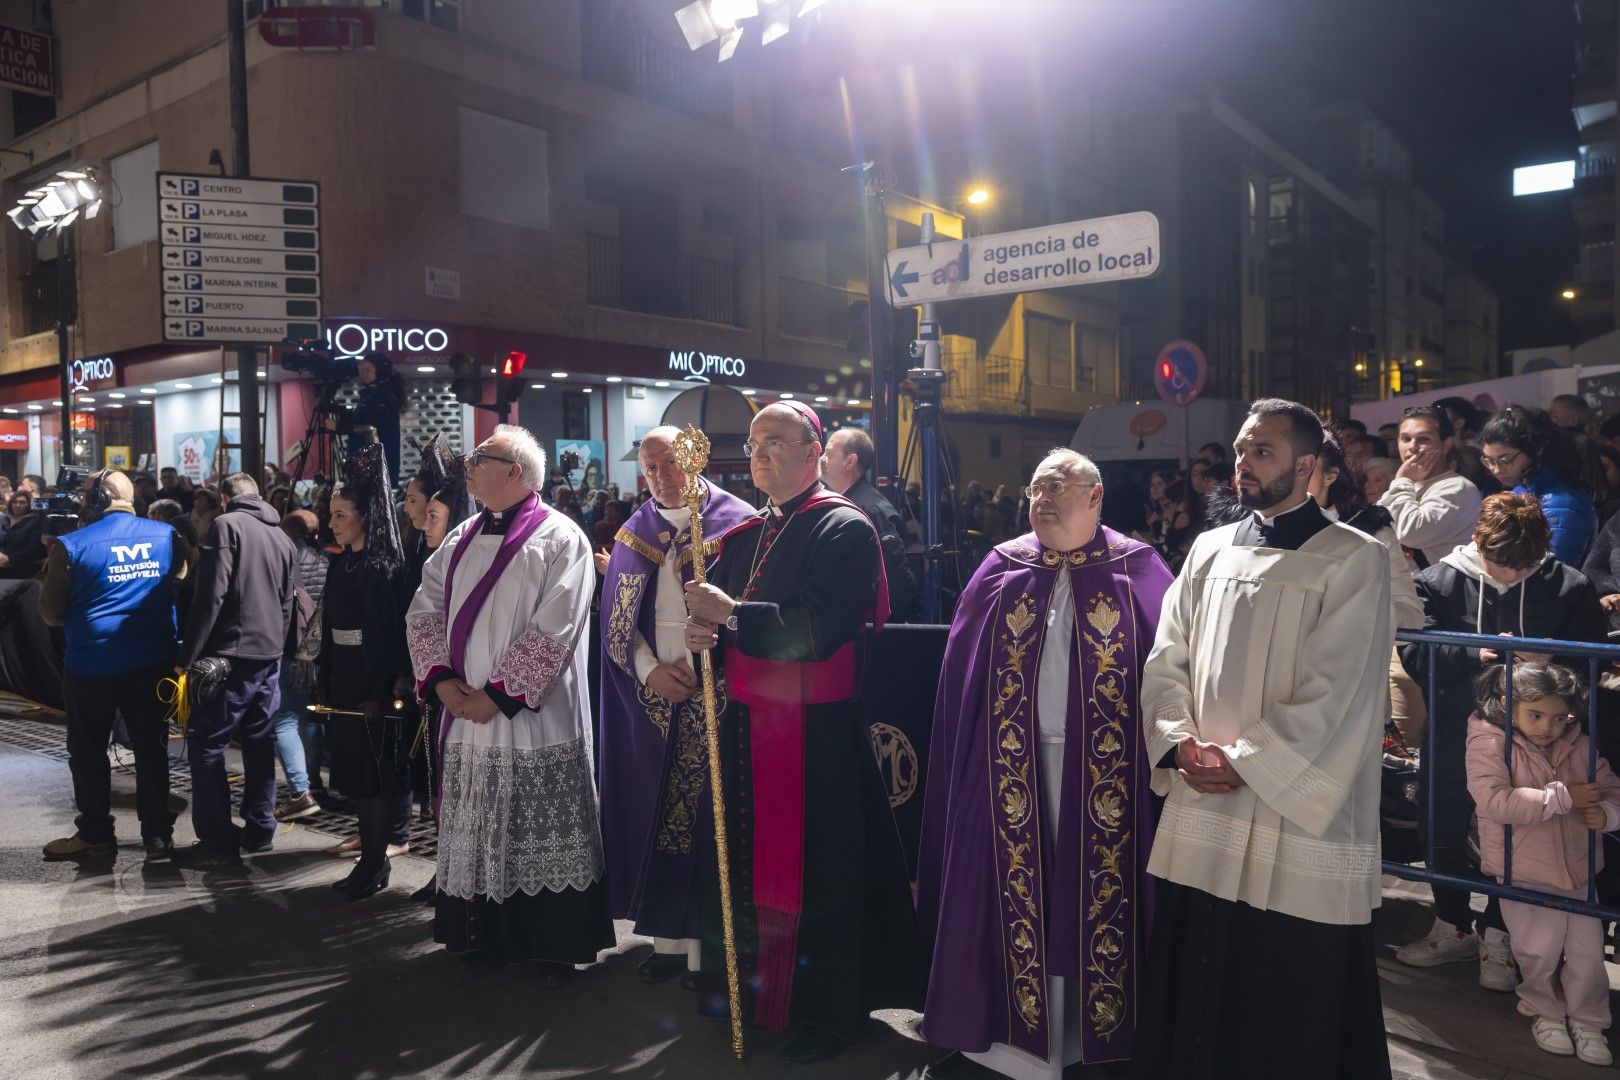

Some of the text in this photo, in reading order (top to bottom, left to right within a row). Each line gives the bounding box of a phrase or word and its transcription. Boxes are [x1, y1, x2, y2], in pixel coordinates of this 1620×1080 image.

[20, 34, 41, 52] DE
[183, 180, 243, 196] P CENTRO
[184, 204, 198, 219] P
[202, 207, 217, 217] LA
[217, 208, 249, 219] PLASA
[184, 227, 198, 243] P
[203, 231, 239, 242] MIGUEL
[983, 230, 1100, 264] agencia de
[185, 251, 199, 266] P
[204, 256, 263, 266] VISTALEGRE
[983, 246, 1153, 286] desarrollo local
[186, 274, 200, 290] P
[204, 279, 242, 288] MARINA
[187, 298, 201, 313] P
[205, 302, 244, 311] PUERTO
[188, 321, 201, 336] P
[206, 325, 243, 335] MARINA
[246, 326, 286, 336] SALINAS
[326, 323, 448, 356] IOPTICO
[69, 357, 114, 386] IOPTICO
[668, 350, 746, 377] MIOPTICO
[110, 542, 153, 563] TVT
[107, 560, 160, 574] TELEVISIÓN
[106, 569, 161, 583] TORREVIEJA
